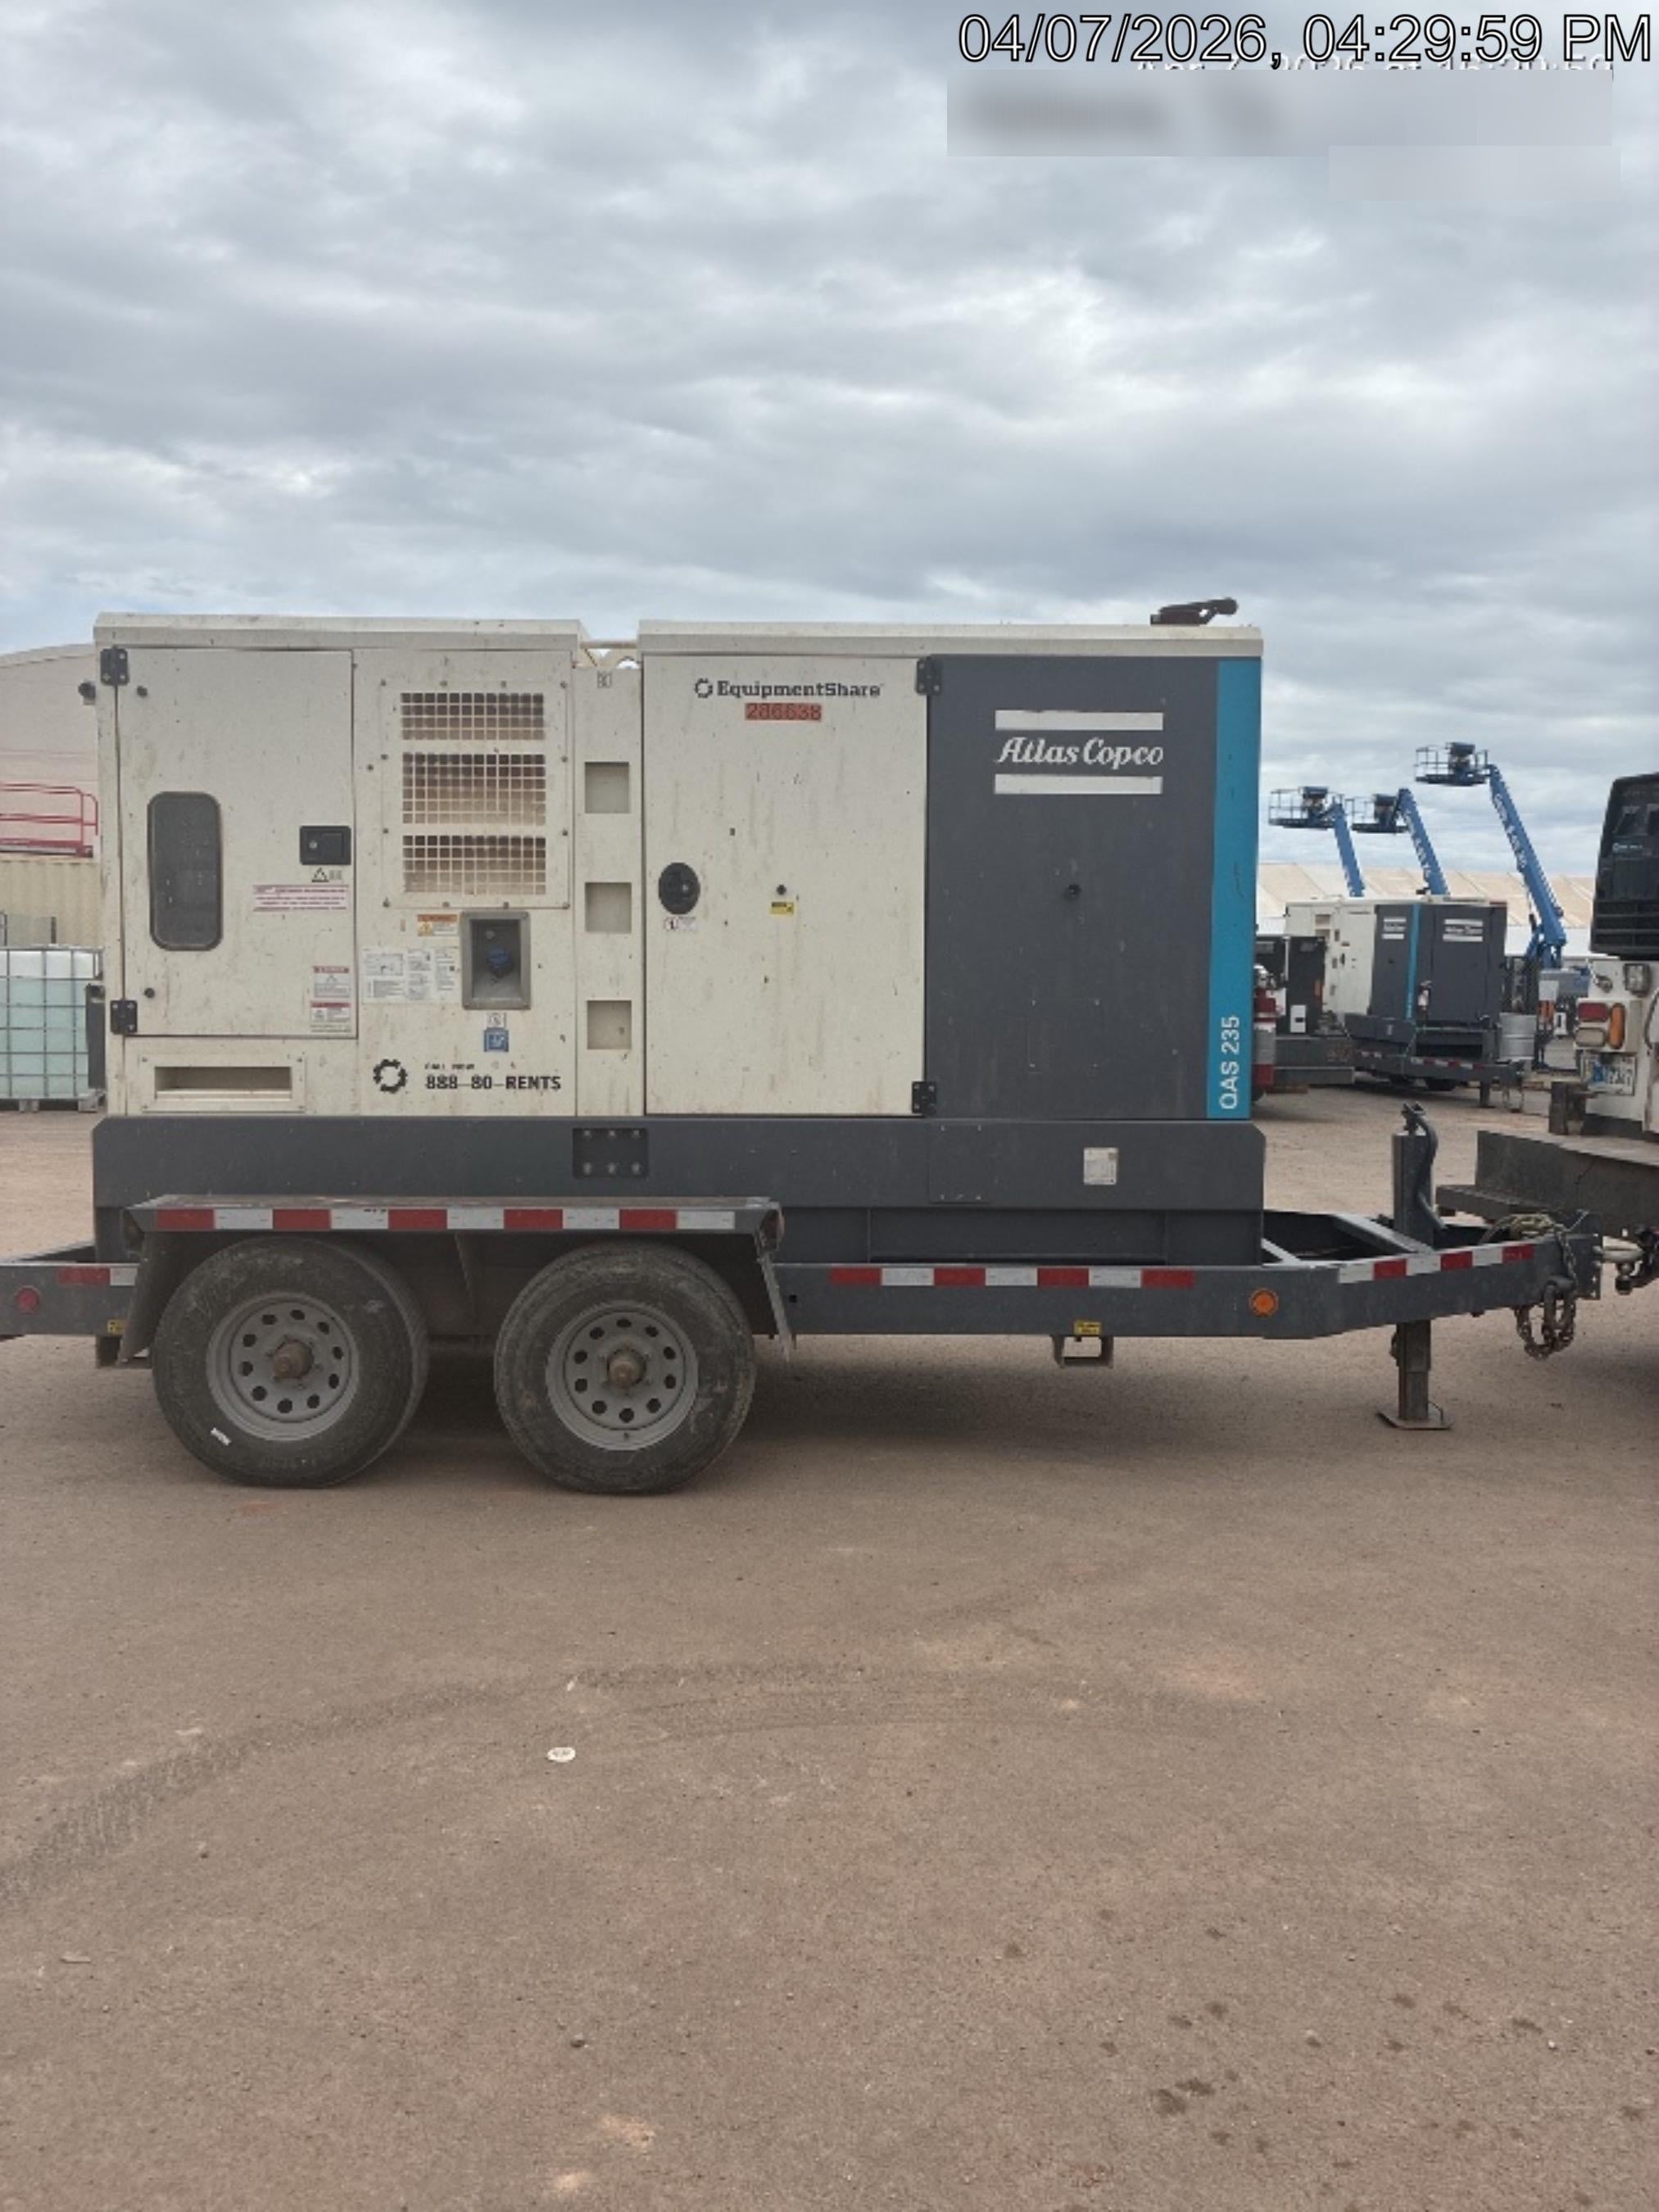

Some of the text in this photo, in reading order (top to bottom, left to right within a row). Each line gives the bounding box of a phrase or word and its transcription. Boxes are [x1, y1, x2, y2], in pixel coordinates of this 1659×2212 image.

[717, 680, 881, 698] EquipmentShare
[995, 737, 1164, 770] Atlas Copco
[1221, 1015, 1240, 1054] 235
